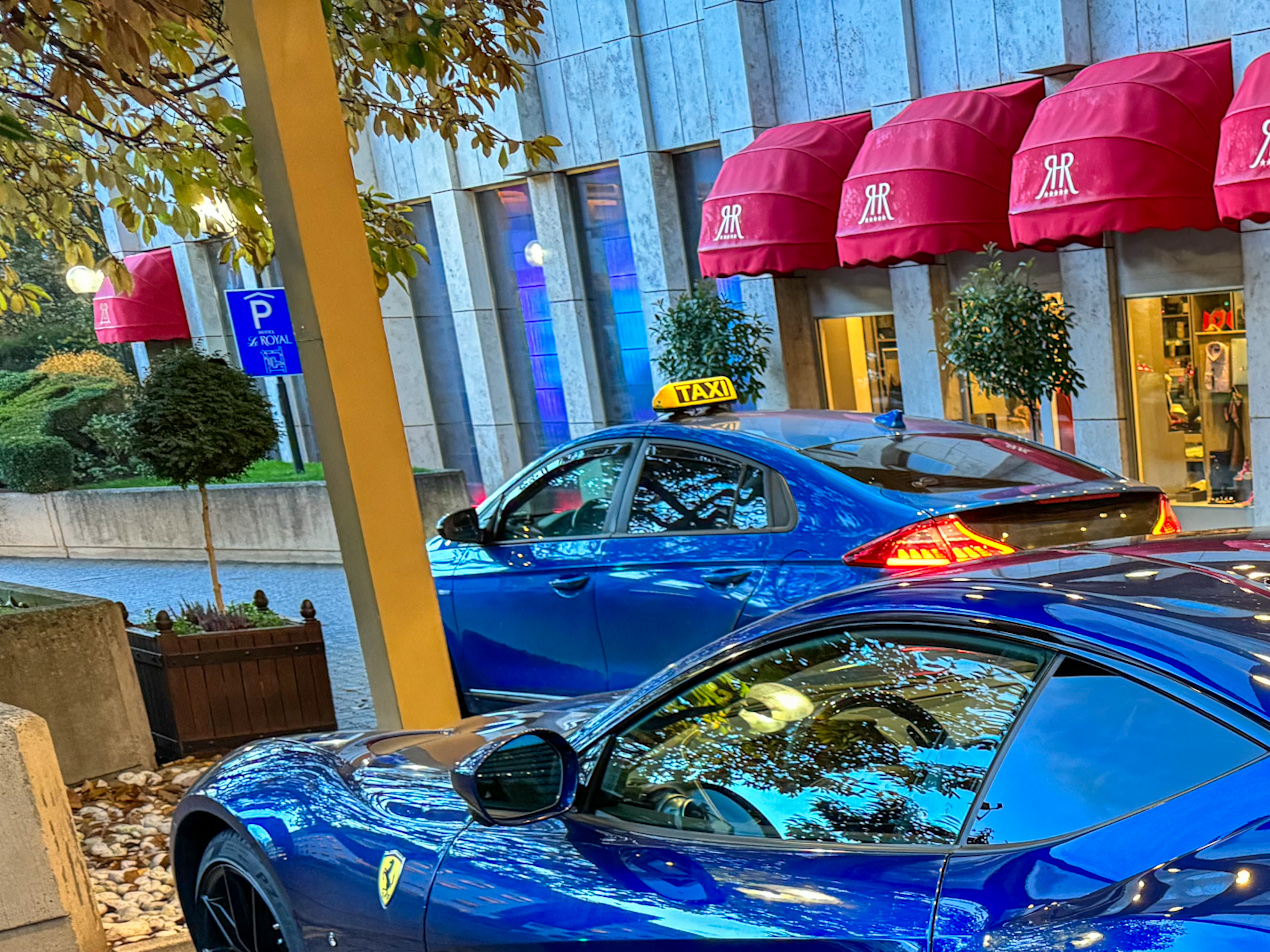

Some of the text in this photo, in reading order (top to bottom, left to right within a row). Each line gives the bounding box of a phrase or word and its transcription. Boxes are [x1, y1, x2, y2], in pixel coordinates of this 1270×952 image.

[249, 299, 273, 330] P
[259, 334, 293, 347] ROYAL
[675, 380, 731, 402] TAXI
